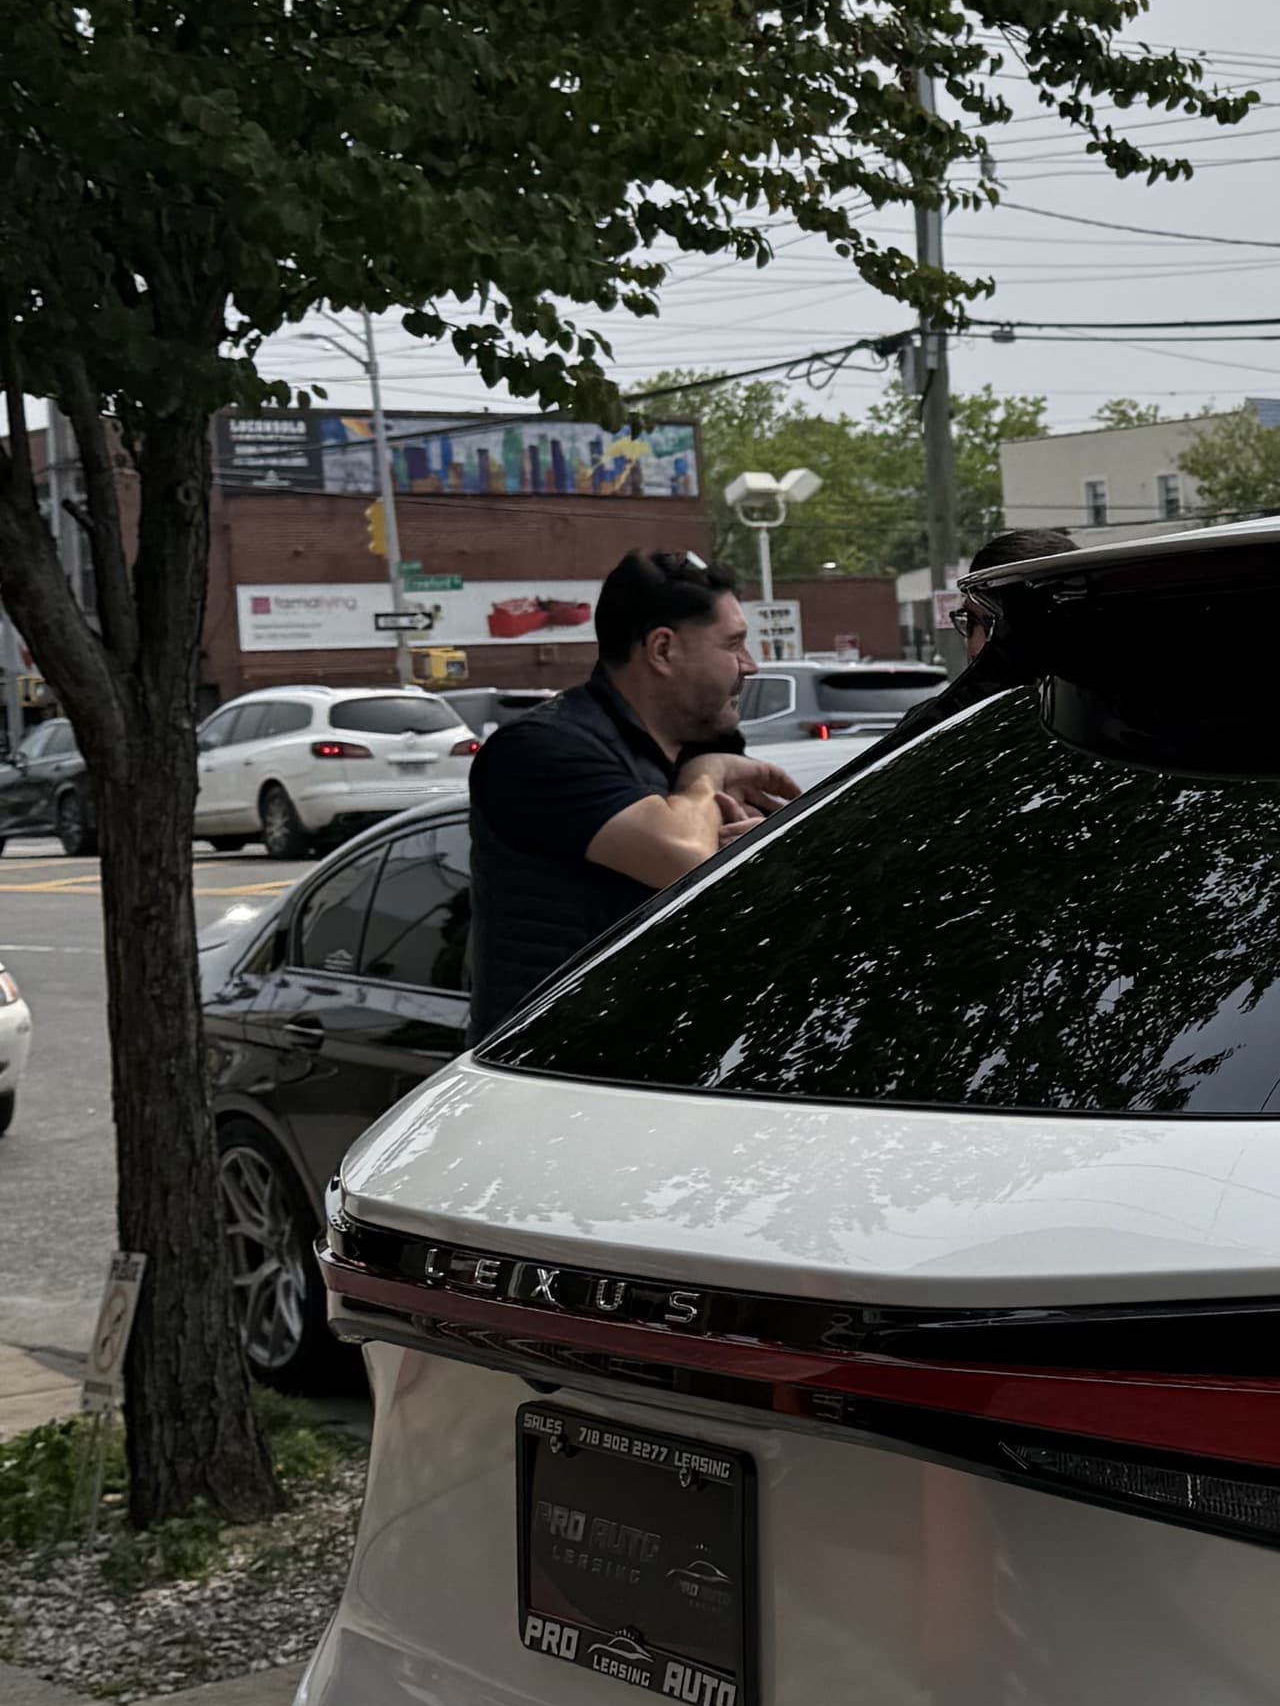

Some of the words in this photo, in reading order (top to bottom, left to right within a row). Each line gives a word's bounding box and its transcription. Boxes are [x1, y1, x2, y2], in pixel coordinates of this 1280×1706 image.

[425, 1248, 701, 1324] LEXUS
[523, 1412, 563, 1435] SALES
[578, 1426, 600, 1445] 718
[603, 1432, 629, 1453] 902
[631, 1440, 669, 1462] 2277
[673, 1450, 731, 1479] LEASING
[534, 1500, 587, 1542] PRO
[551, 1543, 641, 1584] LEASING
[524, 1615, 580, 1660] PRO
[593, 1653, 651, 1687] LEASING
